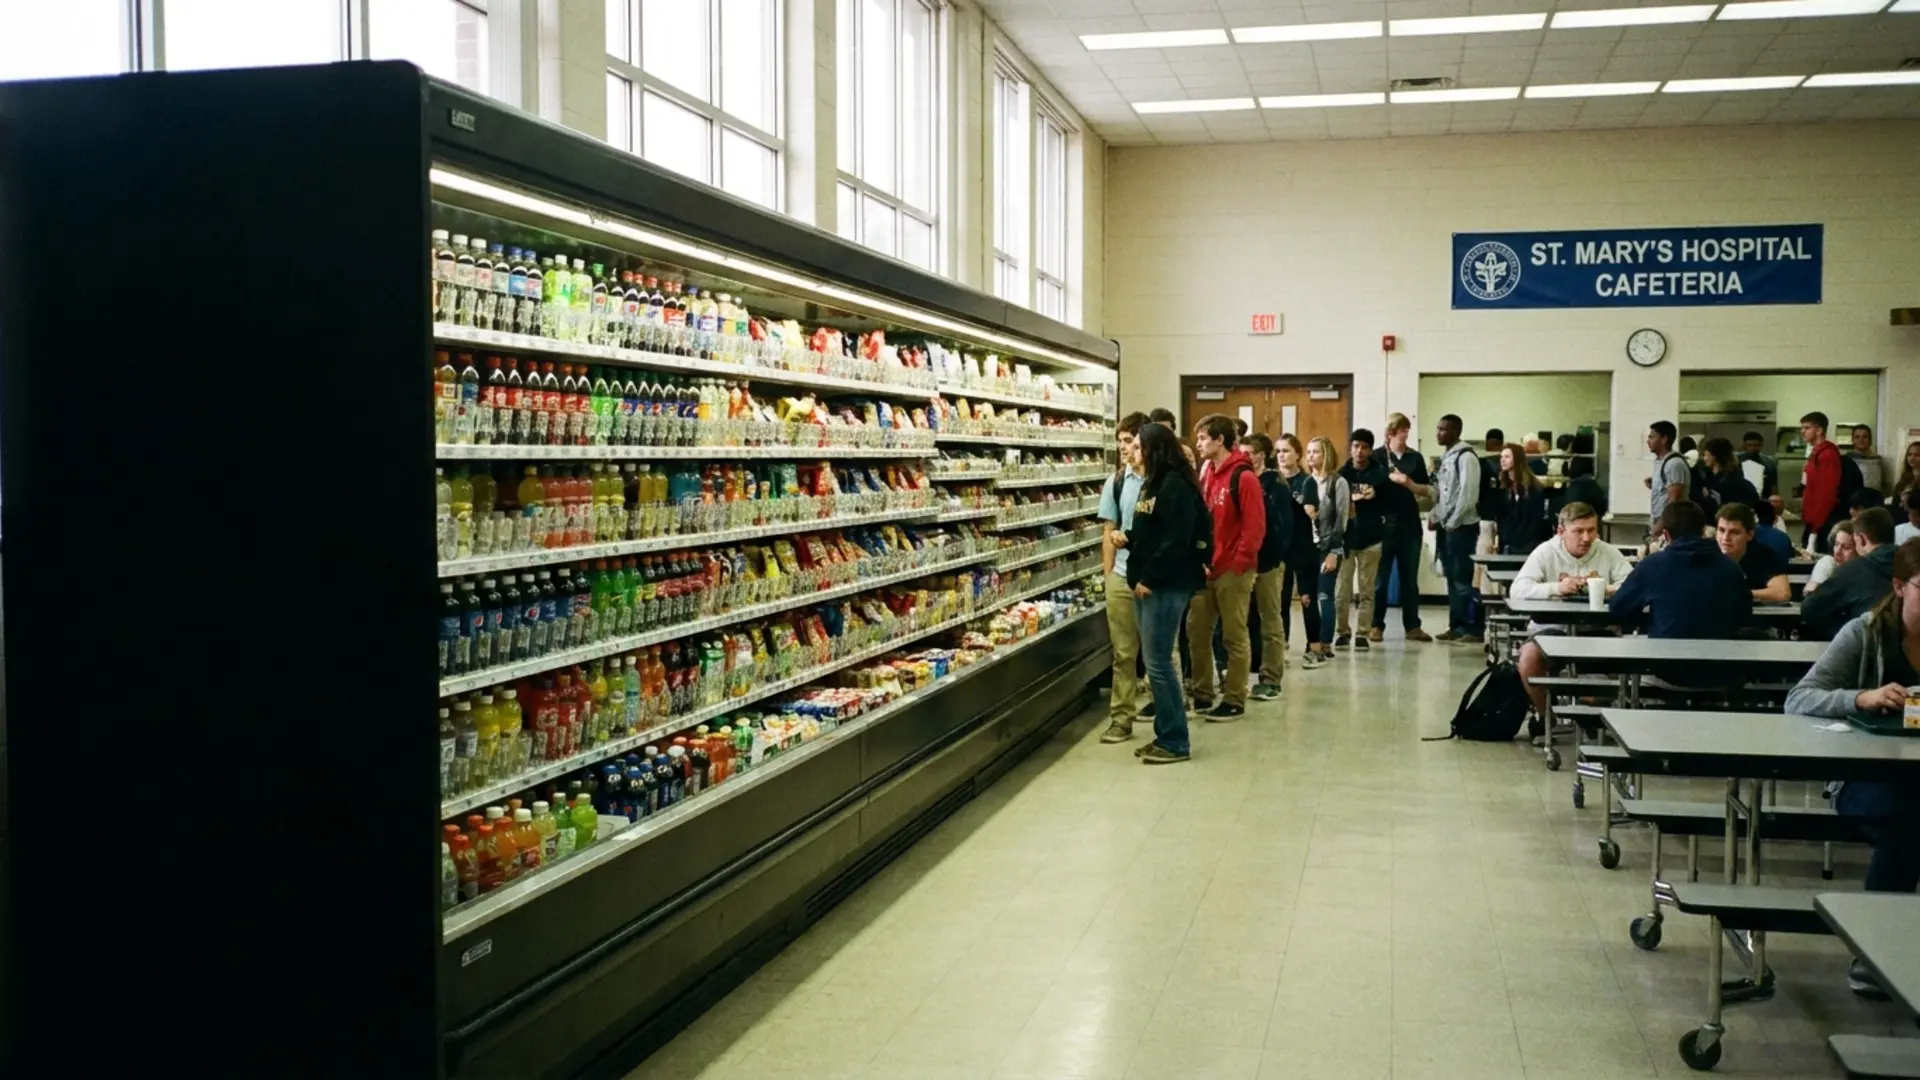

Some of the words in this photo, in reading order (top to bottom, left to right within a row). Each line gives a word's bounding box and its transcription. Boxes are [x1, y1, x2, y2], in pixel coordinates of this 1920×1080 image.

[1530, 242, 1566, 266] ST.
[1575, 239, 1674, 265] MARY'S
[1682, 237, 1812, 263] HOSPITAL
[1595, 271, 1743, 297] CAFETERIA
[1252, 314, 1276, 331] EXIT
